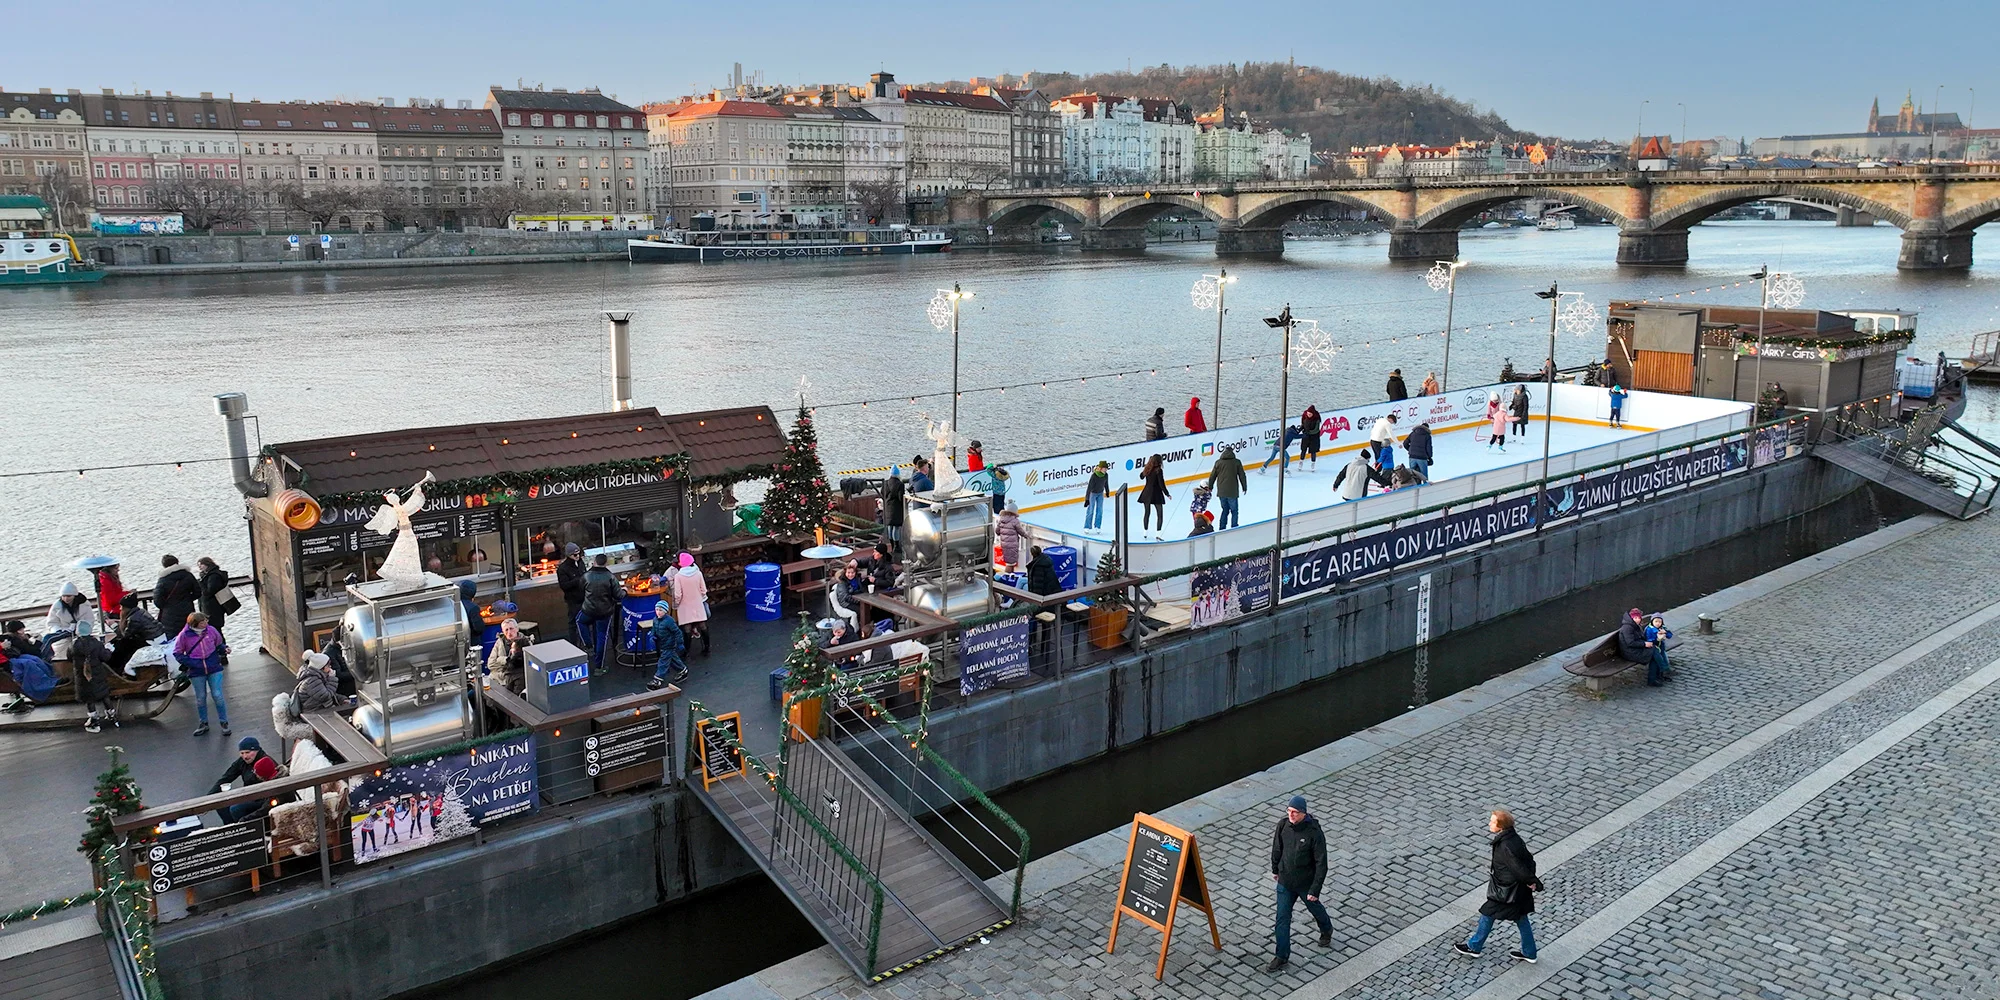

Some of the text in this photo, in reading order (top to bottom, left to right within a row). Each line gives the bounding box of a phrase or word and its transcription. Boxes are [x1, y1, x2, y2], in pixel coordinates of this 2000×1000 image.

[722, 247, 844, 258] CARGO GALLERY
[1792, 350, 1816, 360] GIFTS
[1466, 396, 1485, 406] Diana
[1430, 404, 1452, 414] MŮŽE BÝT
[1424, 416, 1436, 424] VAŠE
[1438, 414, 1459, 422] REKLAMA
[1322, 422, 1348, 430] MATTONI
[1248, 436, 1260, 447] TV
[1135, 448, 1194, 469] BLPUNKT
[1043, 460, 1115, 482] Friends Forer
[1577, 449, 1726, 510] ZIMNÍ KLUZIŠTĚ NA PETŘE
[970, 480, 994, 492] Dia
[344, 505, 378, 522] MAS
[350, 531, 358, 551] GRIL
[1292, 504, 1529, 588] ICE ARENA ON VLTAVA RIVER
[1248, 586, 1257, 595] THE
[1000, 634, 1014, 645] AKCE
[966, 657, 996, 674] REKLAMNÍ
[554, 666, 582, 684] ATM
[471, 739, 529, 766] UNIKÁTNÍ
[472, 780, 532, 807] NA PETŘE!
[1146, 830, 1160, 841] ARENA
